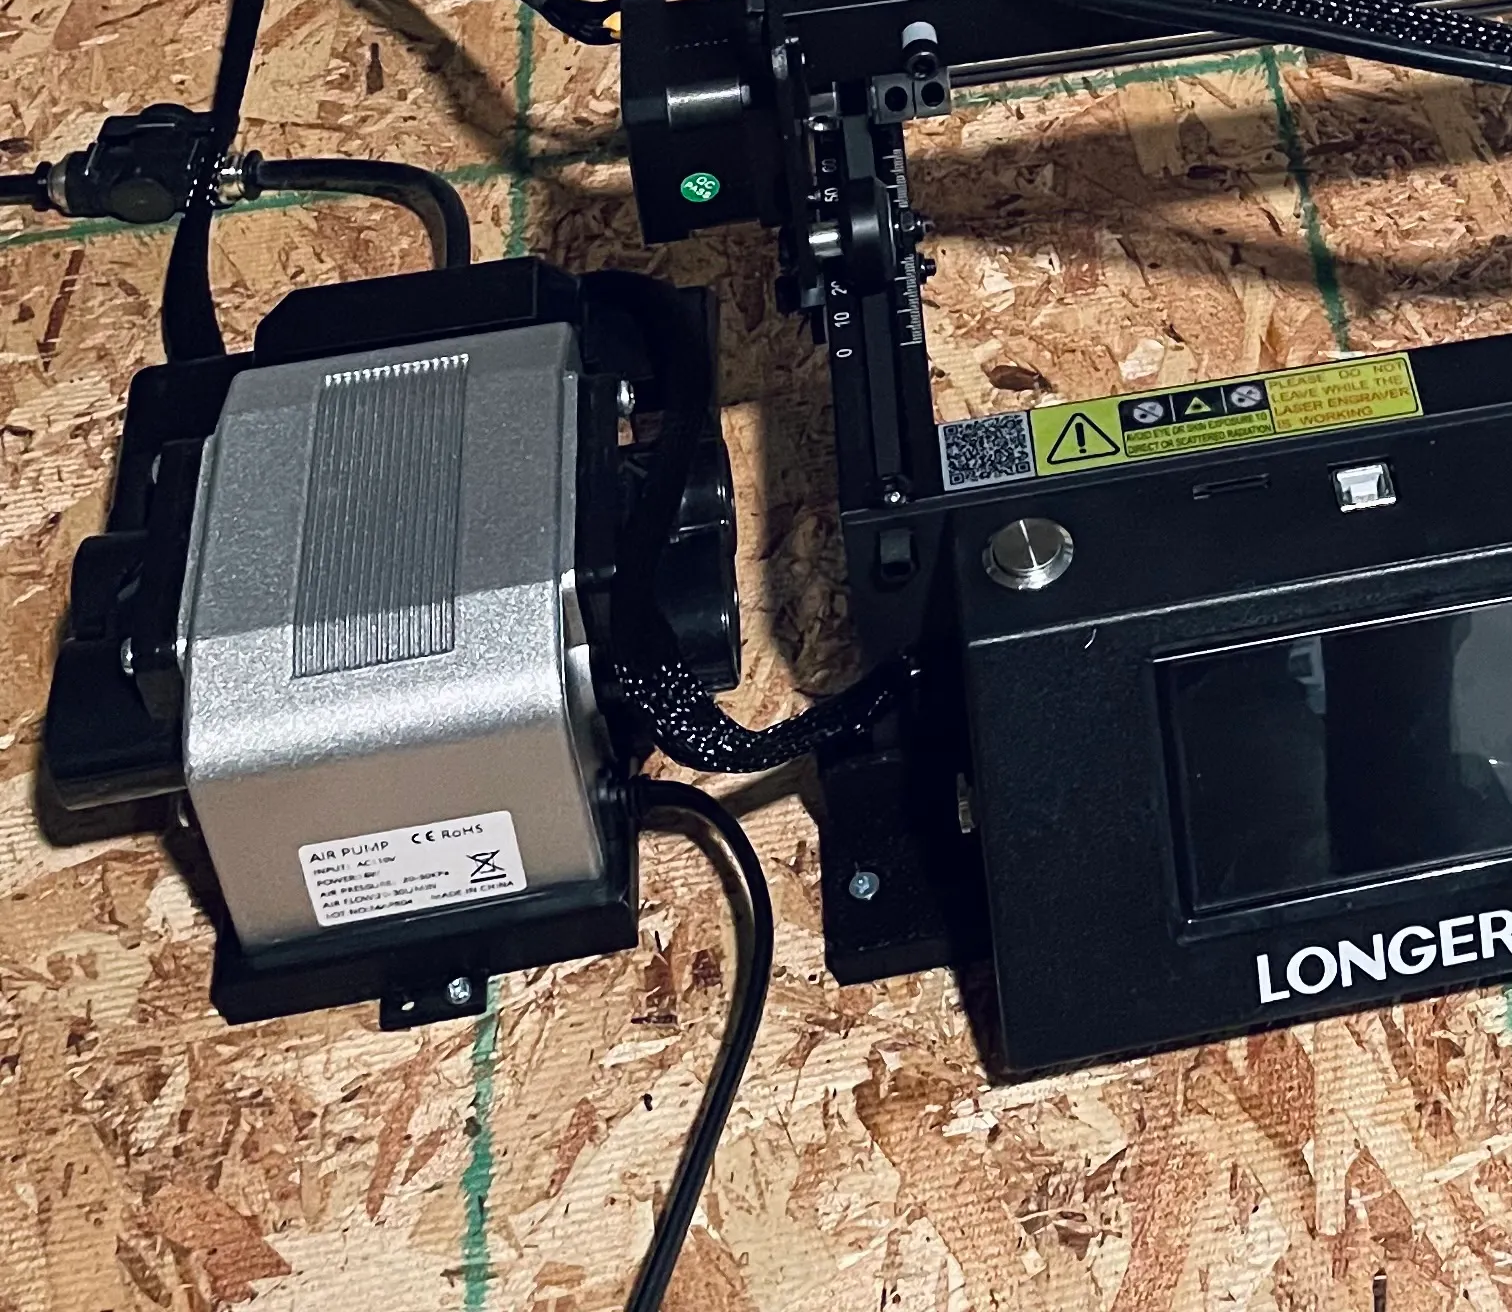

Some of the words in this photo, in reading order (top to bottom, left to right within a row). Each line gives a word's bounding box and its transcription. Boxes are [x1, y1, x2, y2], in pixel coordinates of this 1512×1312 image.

[696, 176, 716, 189] QC
[824, 187, 839, 202] 50
[833, 312, 851, 328] 10
[836, 348, 853, 358] 0
[1269, 373, 1326, 389] PLEASE
[1338, 368, 1361, 379] DO
[1373, 361, 1406, 374] NOT
[1271, 388, 1317, 403] LEAVE
[1323, 380, 1371, 395] WHILE
[1375, 375, 1404, 387] THE
[1273, 400, 1324, 416] LASER
[1328, 388, 1411, 408] ENGRAVER
[1153, 426, 1171, 437] EYE
[1172, 425, 1185, 435] OR
[1208, 415, 1255, 429] EXPOSURE
[1256, 411, 1268, 421] TO
[1277, 419, 1292, 430] IS
[1300, 406, 1374, 426] WORKING
[1128, 442, 1160, 454] DIRECT
[1160, 438, 1175, 449] OR
[411, 830, 435, 844] CE
[441, 824, 484, 840] RoHS
[310, 850, 336, 863] AIR
[341, 841, 389, 857] PUMP
[480, 881, 514, 892] CHINA
[323, 900, 340, 908] AIR
